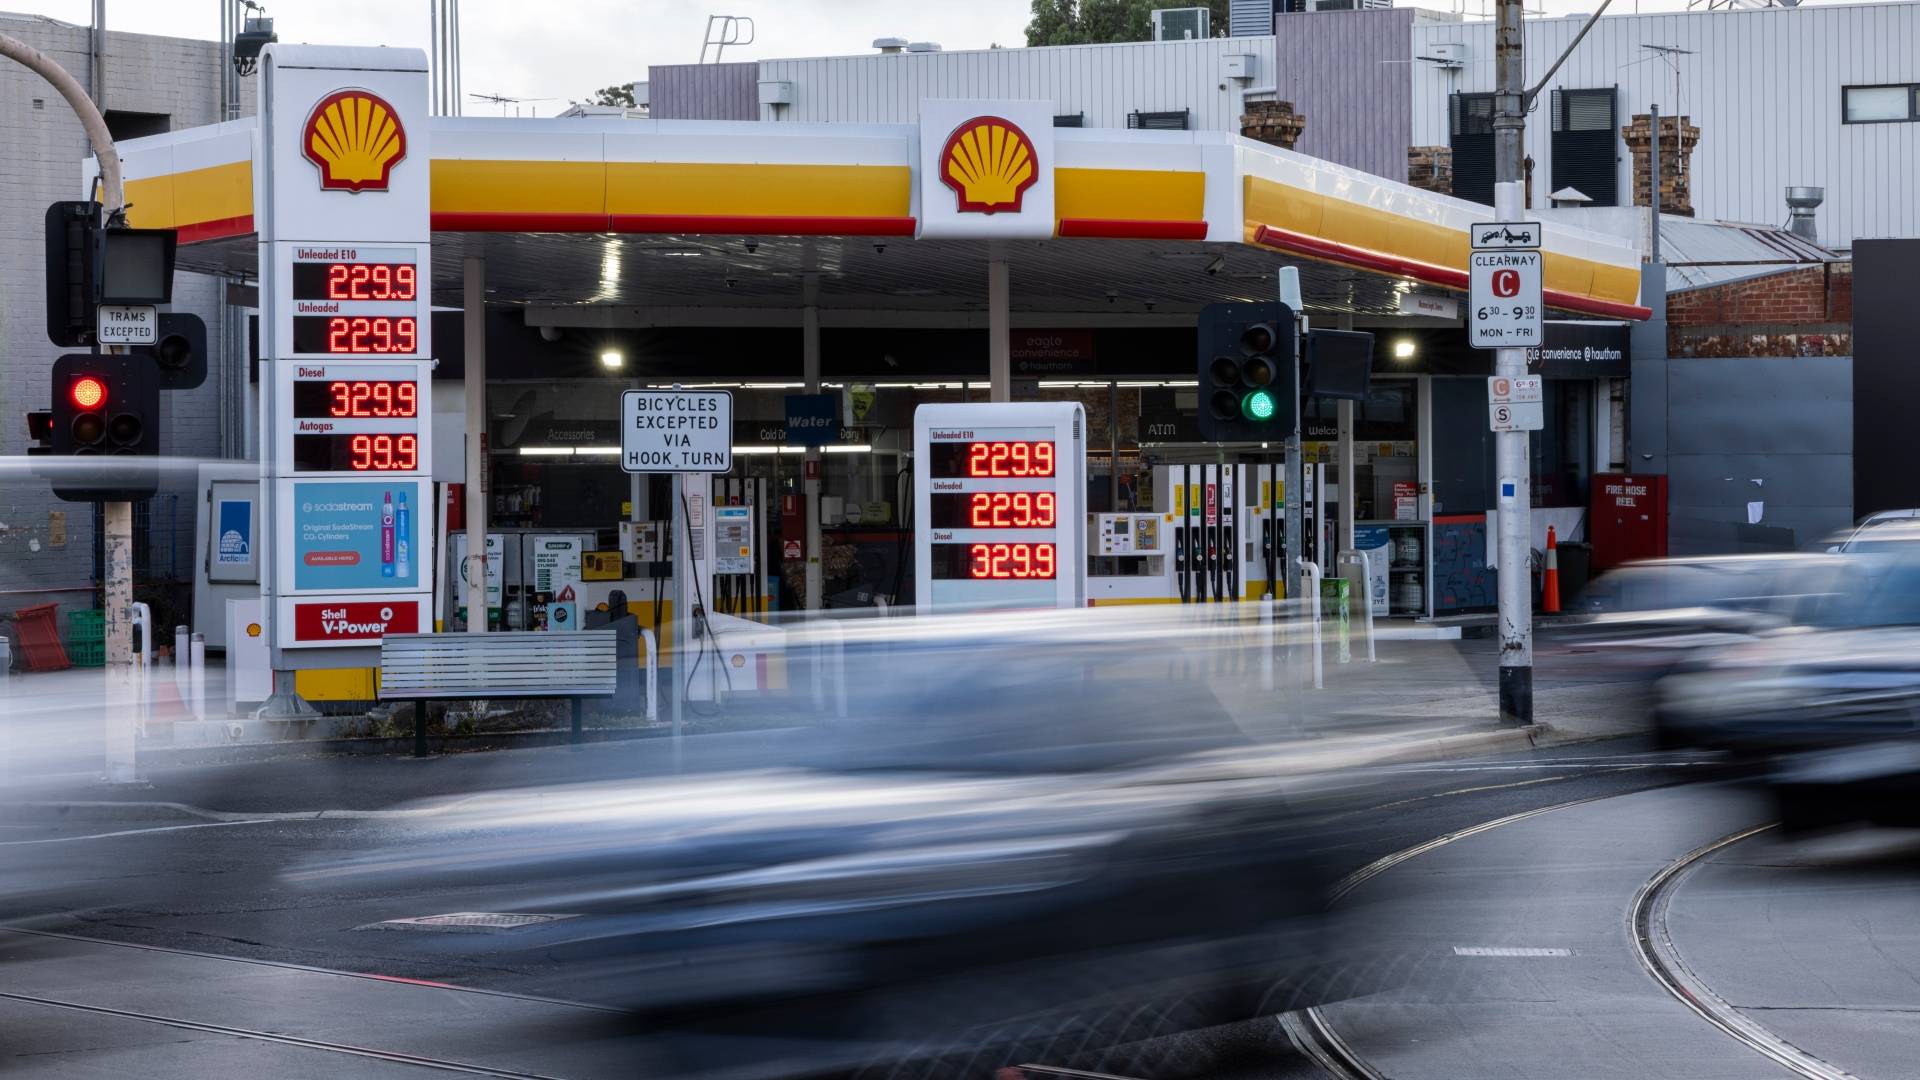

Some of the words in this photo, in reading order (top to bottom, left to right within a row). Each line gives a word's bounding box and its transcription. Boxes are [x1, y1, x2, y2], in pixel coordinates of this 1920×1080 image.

[297, 249, 339, 260] Unleaded
[341, 249, 357, 260] E10
[1475, 255, 1536, 267] CLEARWAY
[330, 265, 415, 299] 229.9
[1499, 271, 1513, 296] C
[298, 302, 339, 313] Unleaded
[109, 311, 146, 322] TRAMS
[104, 326, 151, 337] EXCEPTED
[330, 318, 415, 352] 229.9
[1480, 328, 1503, 337] MON
[1516, 328, 1533, 337] FRI
[1541, 347, 1582, 361] convenience
[298, 367, 325, 378] Diesel
[331, 382, 416, 416] 329.9
[638, 398, 717, 411] BICYCLES
[1498, 409, 1508, 421] S
[299, 420, 334, 432] Autogas
[636, 416, 718, 429] EXCEPTED
[788, 416, 833, 428] Water
[549, 428, 595, 440] Accessories
[760, 428, 777, 440] Cold
[1148, 423, 1176, 435] ATM
[1308, 426, 1338, 435] Welco
[663, 434, 691, 447] VIA
[932, 431, 961, 440] Unleaded
[963, 431, 974, 439] E10
[352, 435, 416, 469] 99.9
[629, 452, 672, 465] HOOK
[682, 452, 724, 465] TURN
[971, 442, 1053, 475] 229.9
[1306, 467, 1311, 475] 2
[933, 481, 962, 490] Unleaded
[1605, 485, 1623, 495] FIRE
[1625, 486, 1647, 496] HOSE
[314, 502, 373, 512] sodastream
[1615, 497, 1635, 507] REEL
[972, 493, 1054, 526] 229.9
[303, 524, 331, 533] Original
[317, 533, 350, 542] Cylinders
[933, 532, 953, 540] Diesel
[971, 544, 1054, 577] 329.9
[321, 608, 347, 620] Shell
[321, 620, 388, 635] V-Power
